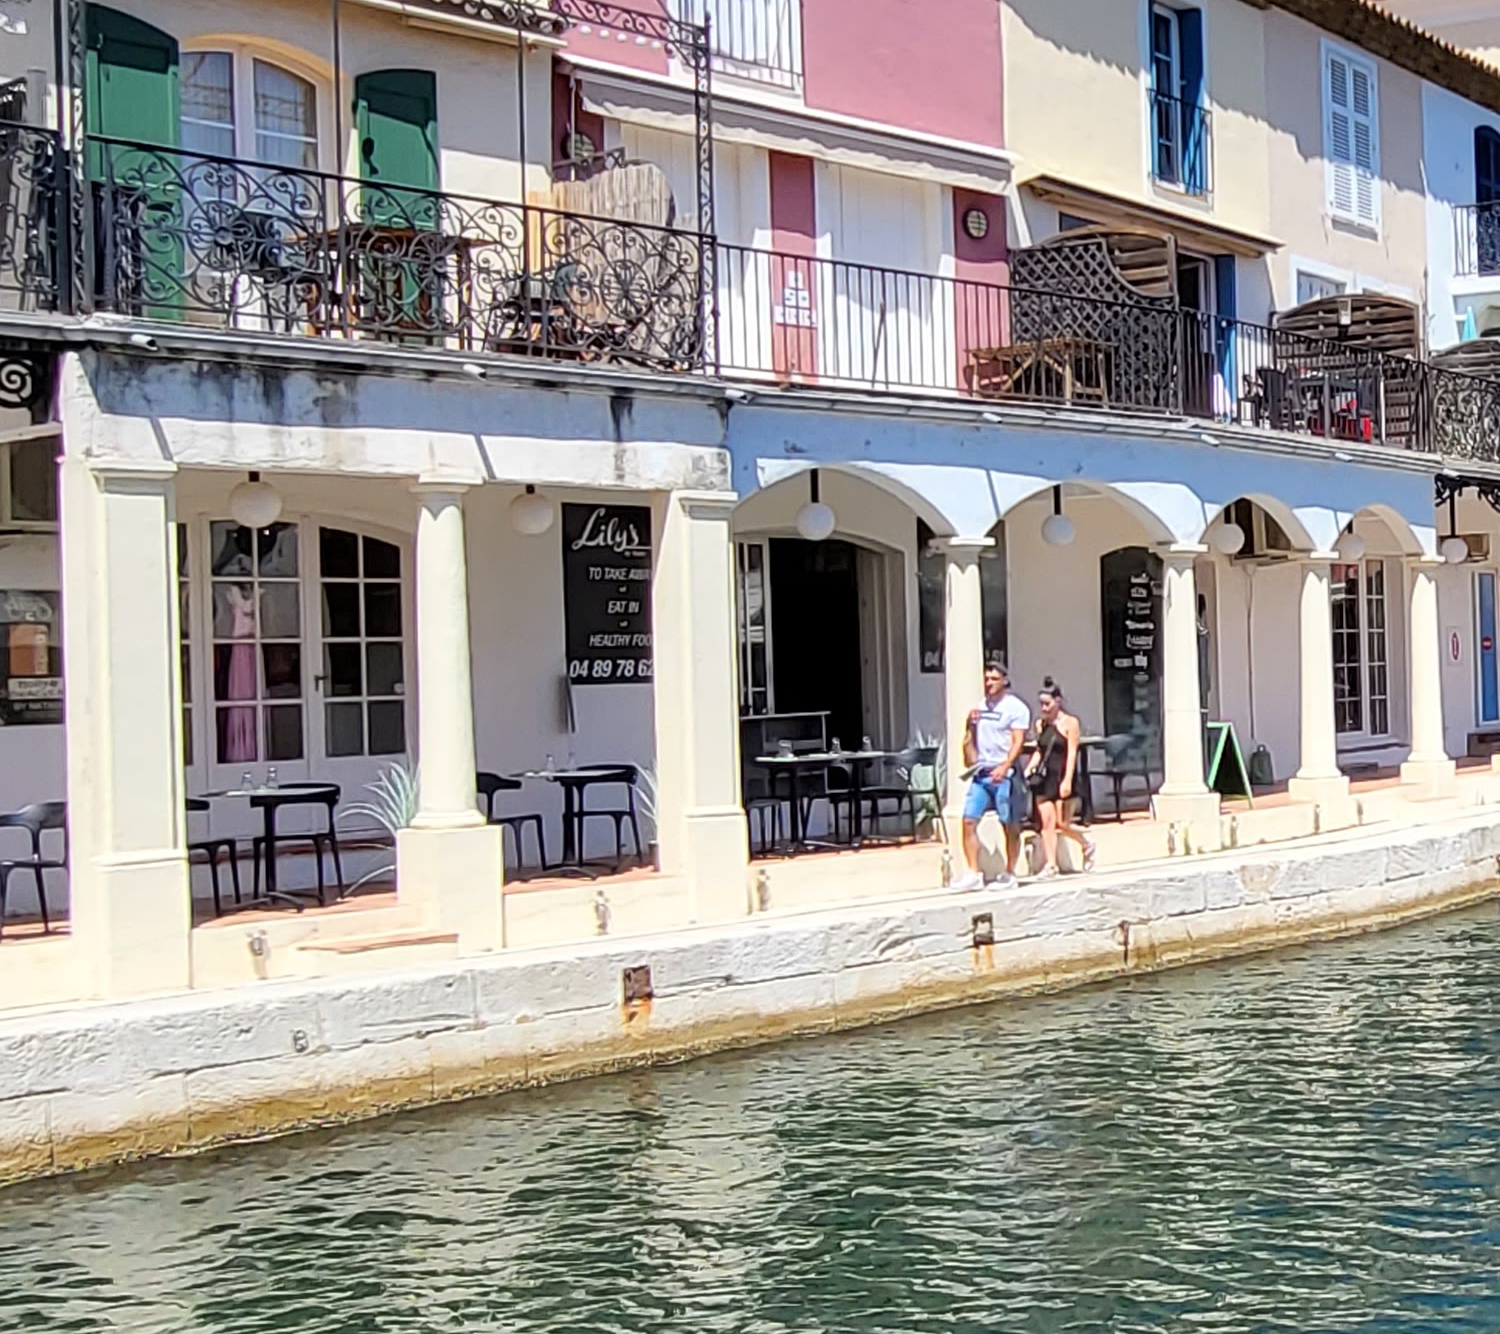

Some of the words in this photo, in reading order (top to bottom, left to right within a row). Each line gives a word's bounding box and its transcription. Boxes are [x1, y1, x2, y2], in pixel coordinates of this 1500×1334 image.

[588, 567, 602, 580] TO
[604, 567, 628, 580] TAKE
[607, 600, 627, 613] EAT
[628, 601, 640, 613] IN
[589, 634, 632, 647] HEALTHY
[632, 634, 653, 647] FOO
[569, 659, 589, 678] 04
[591, 659, 613, 678] 89
[616, 659, 636, 678] 78
